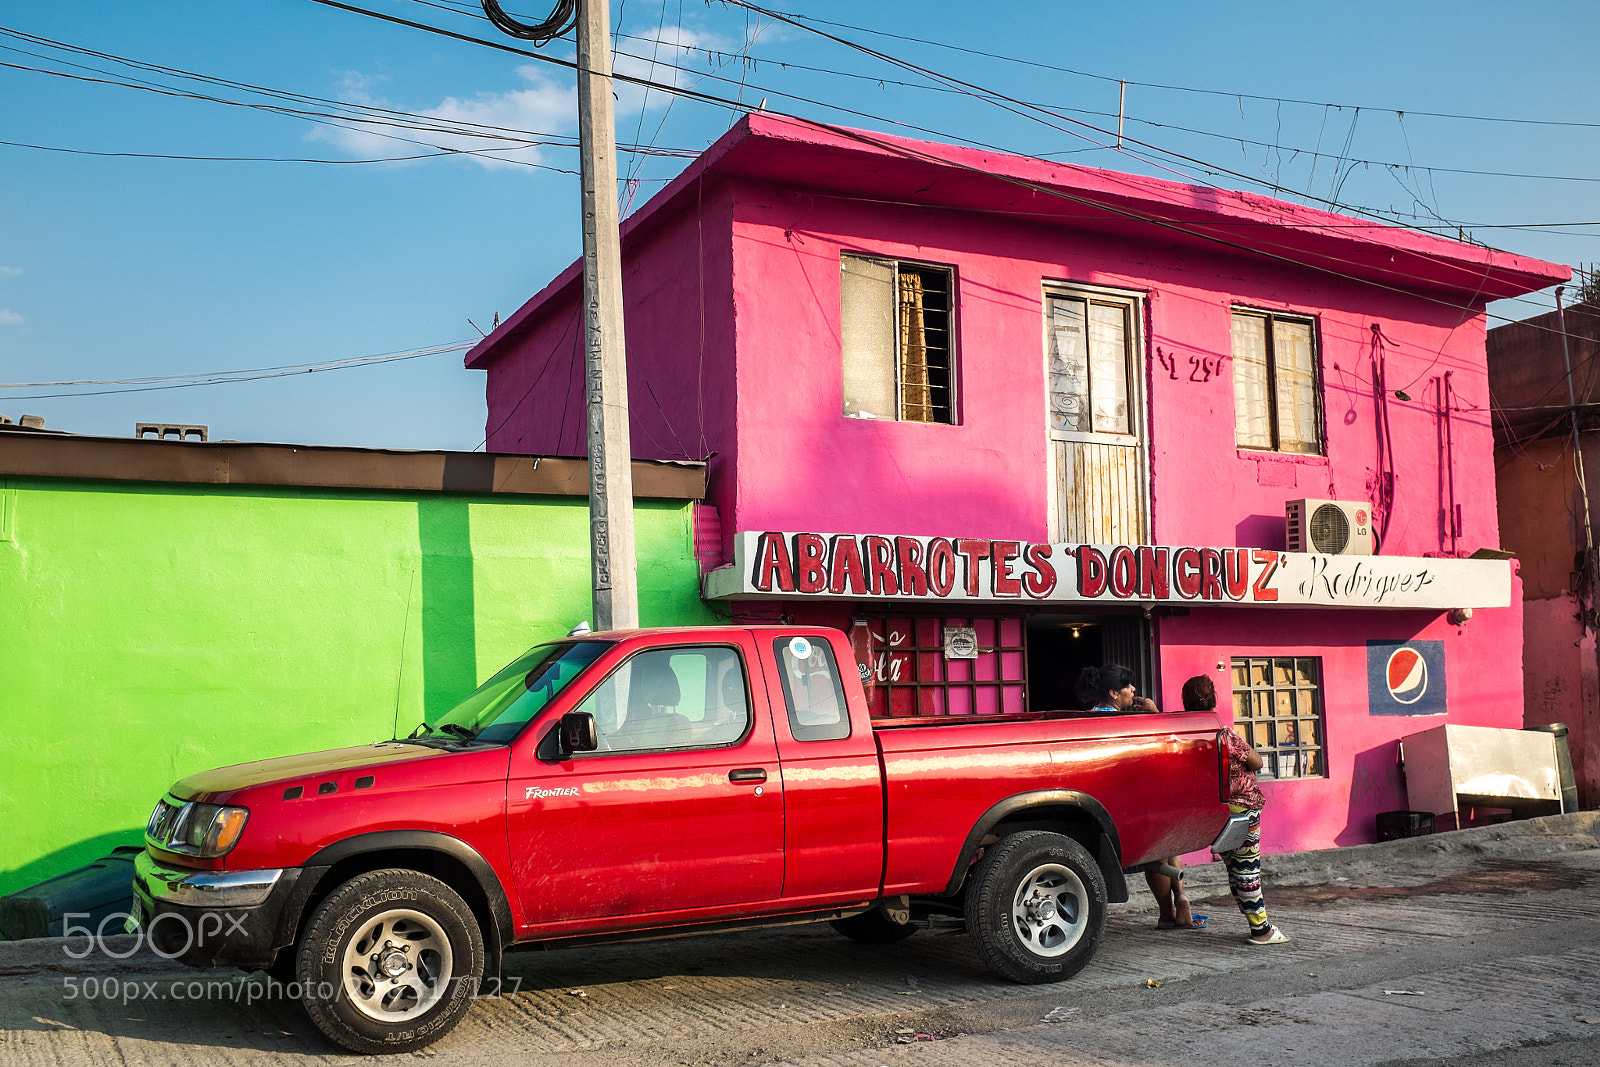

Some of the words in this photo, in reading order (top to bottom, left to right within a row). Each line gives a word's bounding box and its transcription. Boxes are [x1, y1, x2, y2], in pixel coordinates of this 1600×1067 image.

[1357, 528, 1367, 536] LG
[752, 532, 1056, 598] ABARROTES
[524, 786, 580, 800] FRONTIER
[325, 890, 418, 964] BLACKLION
